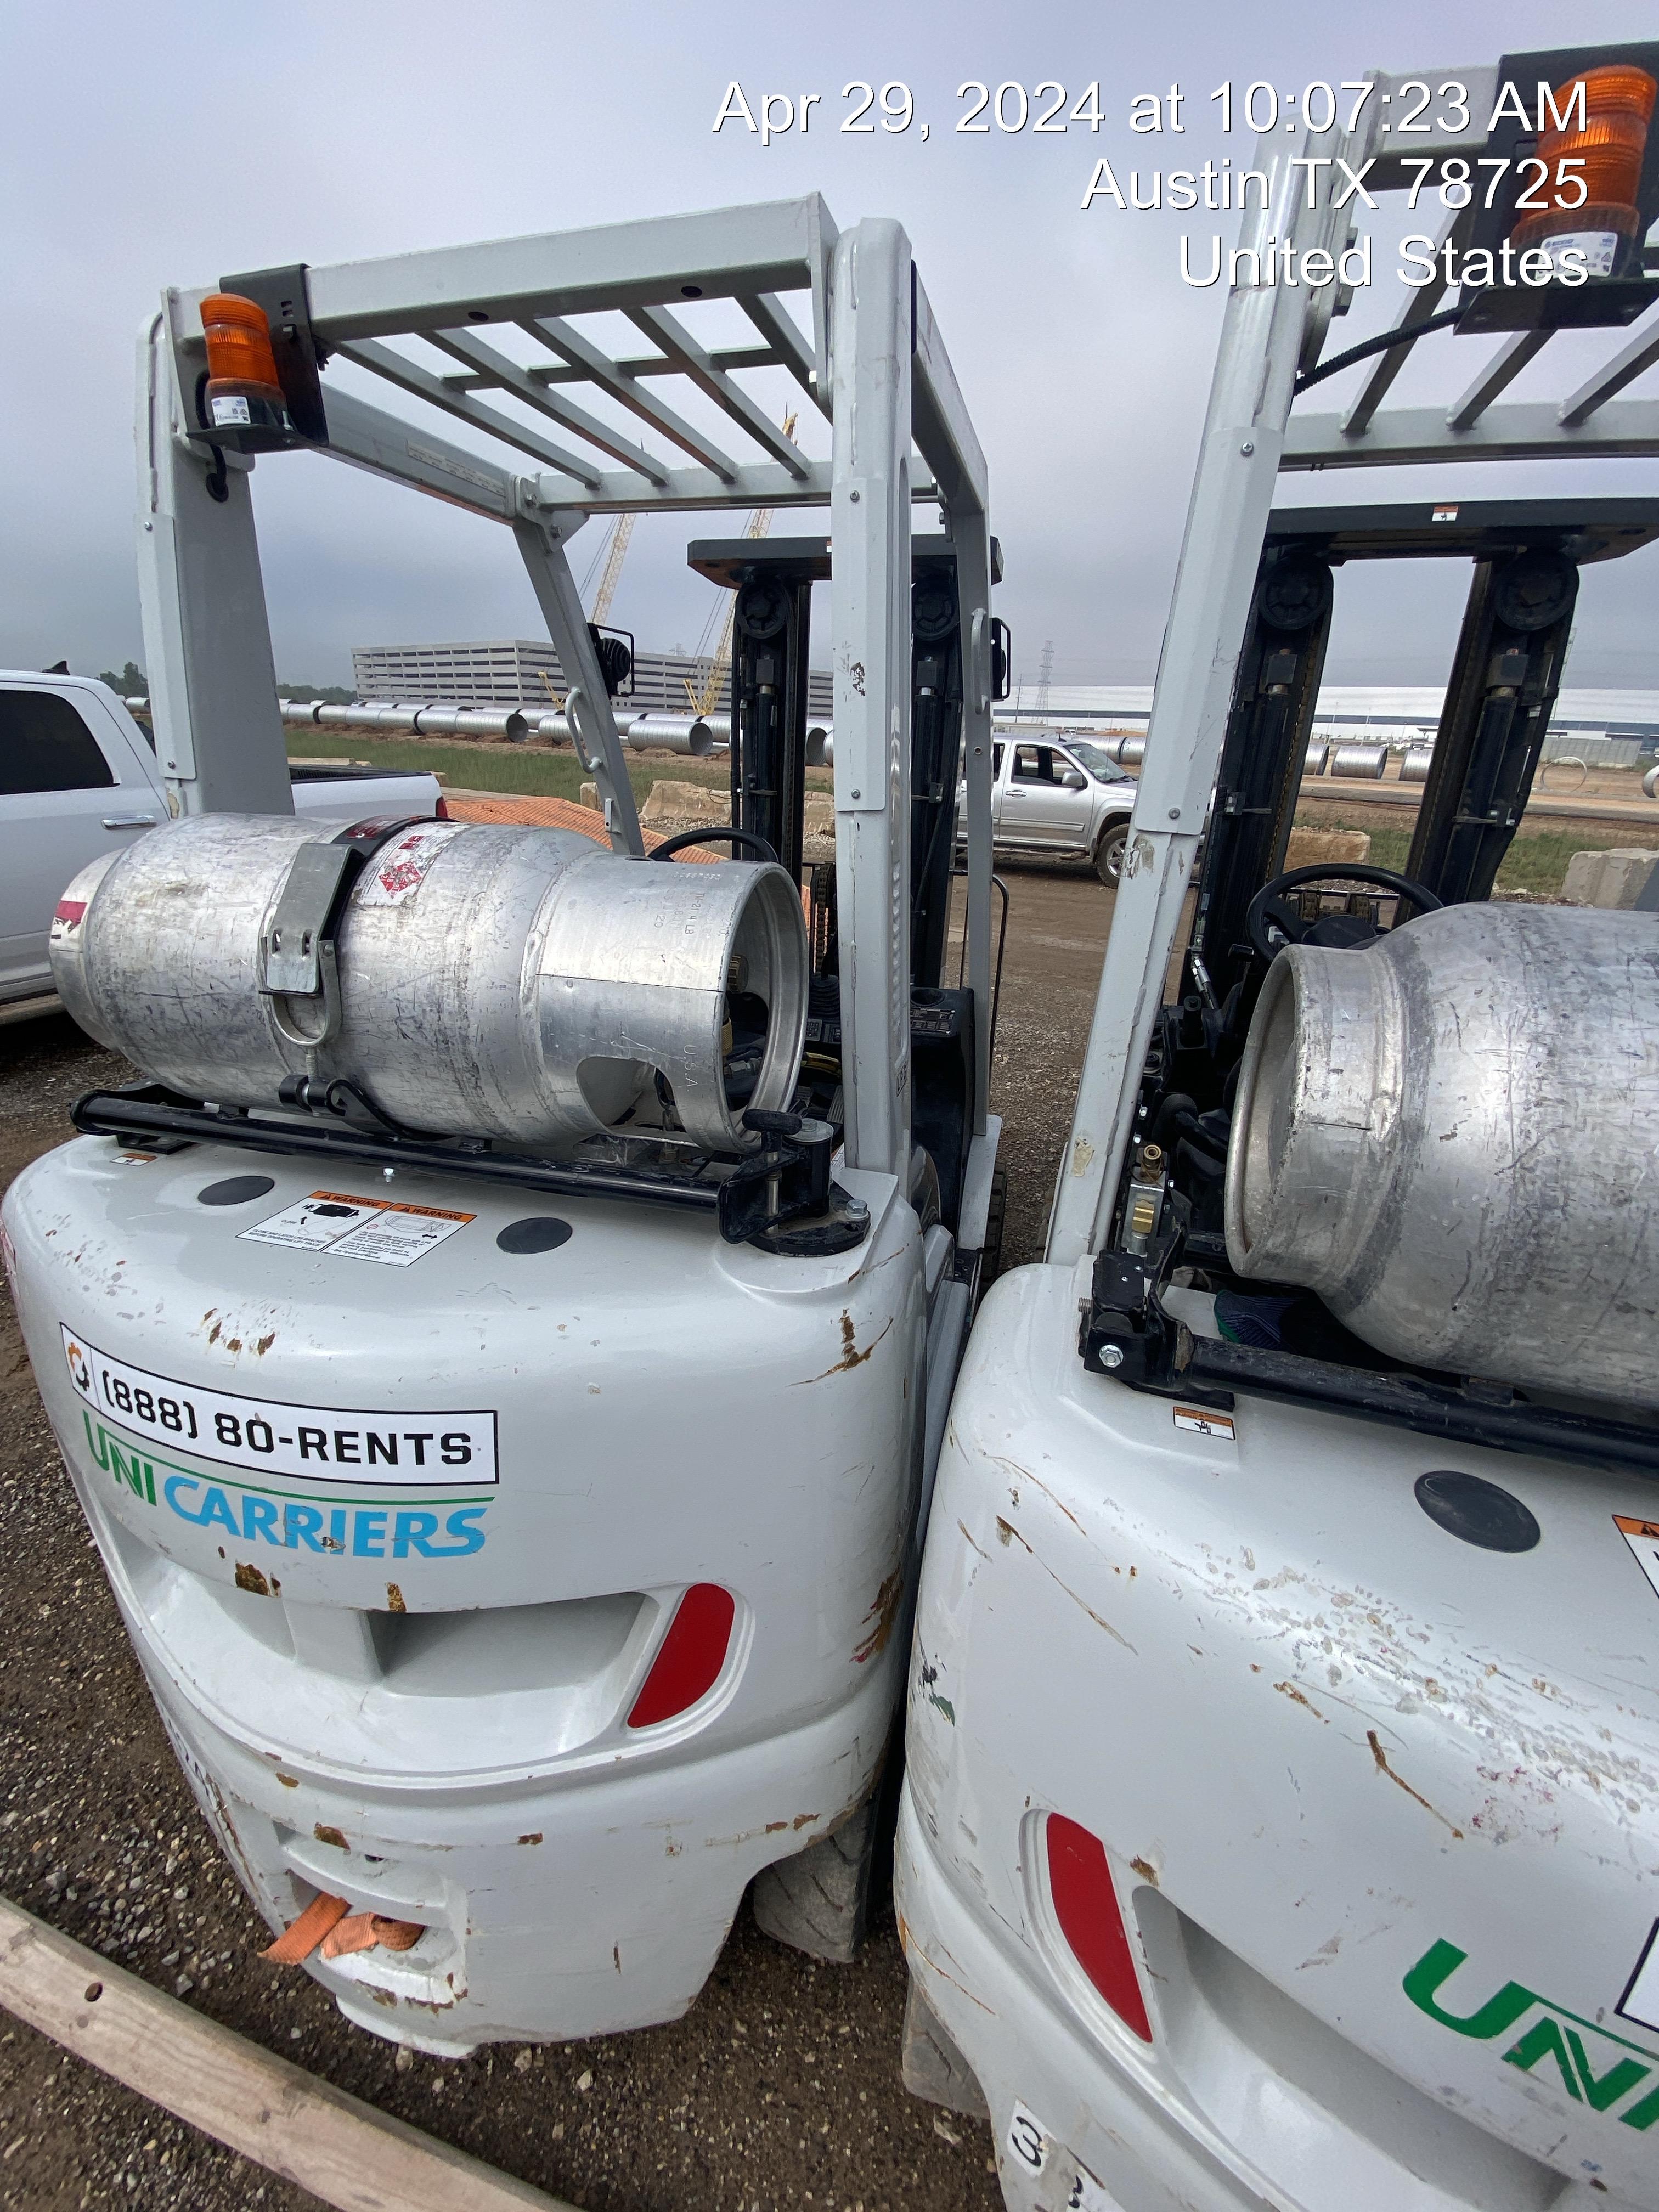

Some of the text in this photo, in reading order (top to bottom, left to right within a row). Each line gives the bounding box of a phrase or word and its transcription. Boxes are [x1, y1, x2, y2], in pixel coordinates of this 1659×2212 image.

[684, 1045, 698, 1092] U.S.A.
[332, 1196, 380, 1206] WARNING
[413, 1208, 462, 1219] WARNING
[101, 1369, 472, 1465] (888) 80-RENTS
